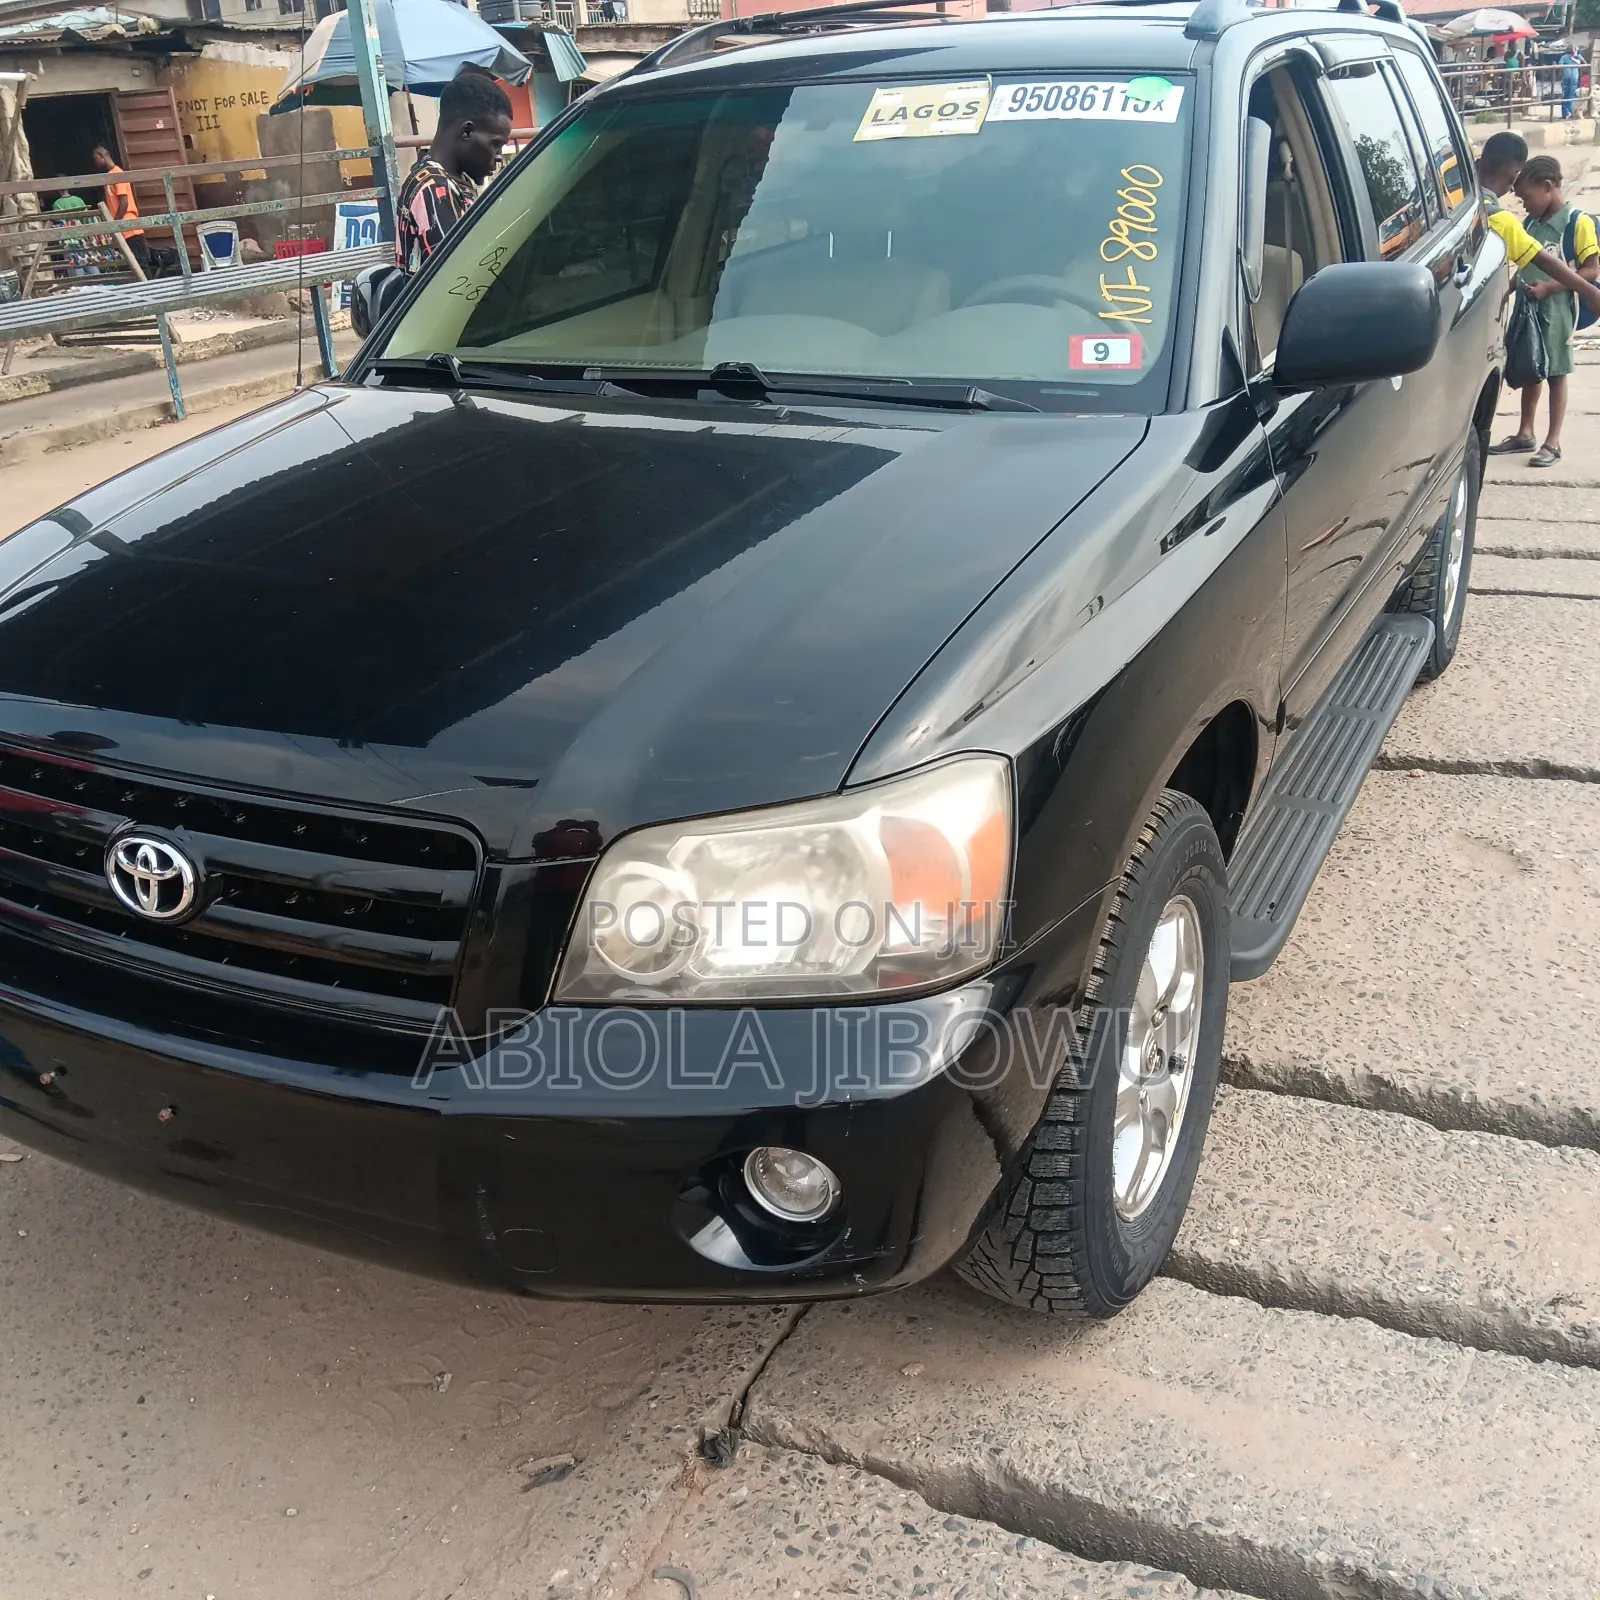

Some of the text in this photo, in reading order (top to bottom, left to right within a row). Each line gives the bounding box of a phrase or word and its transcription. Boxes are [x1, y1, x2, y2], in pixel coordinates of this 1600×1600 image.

[186, 99, 208, 113] NOT
[215, 95, 236, 110] FOR
[240, 91, 270, 107] SALE
[871, 101, 980, 122] LAGOS
[196, 114, 221, 131] III
[1093, 342, 1110, 361] 9
